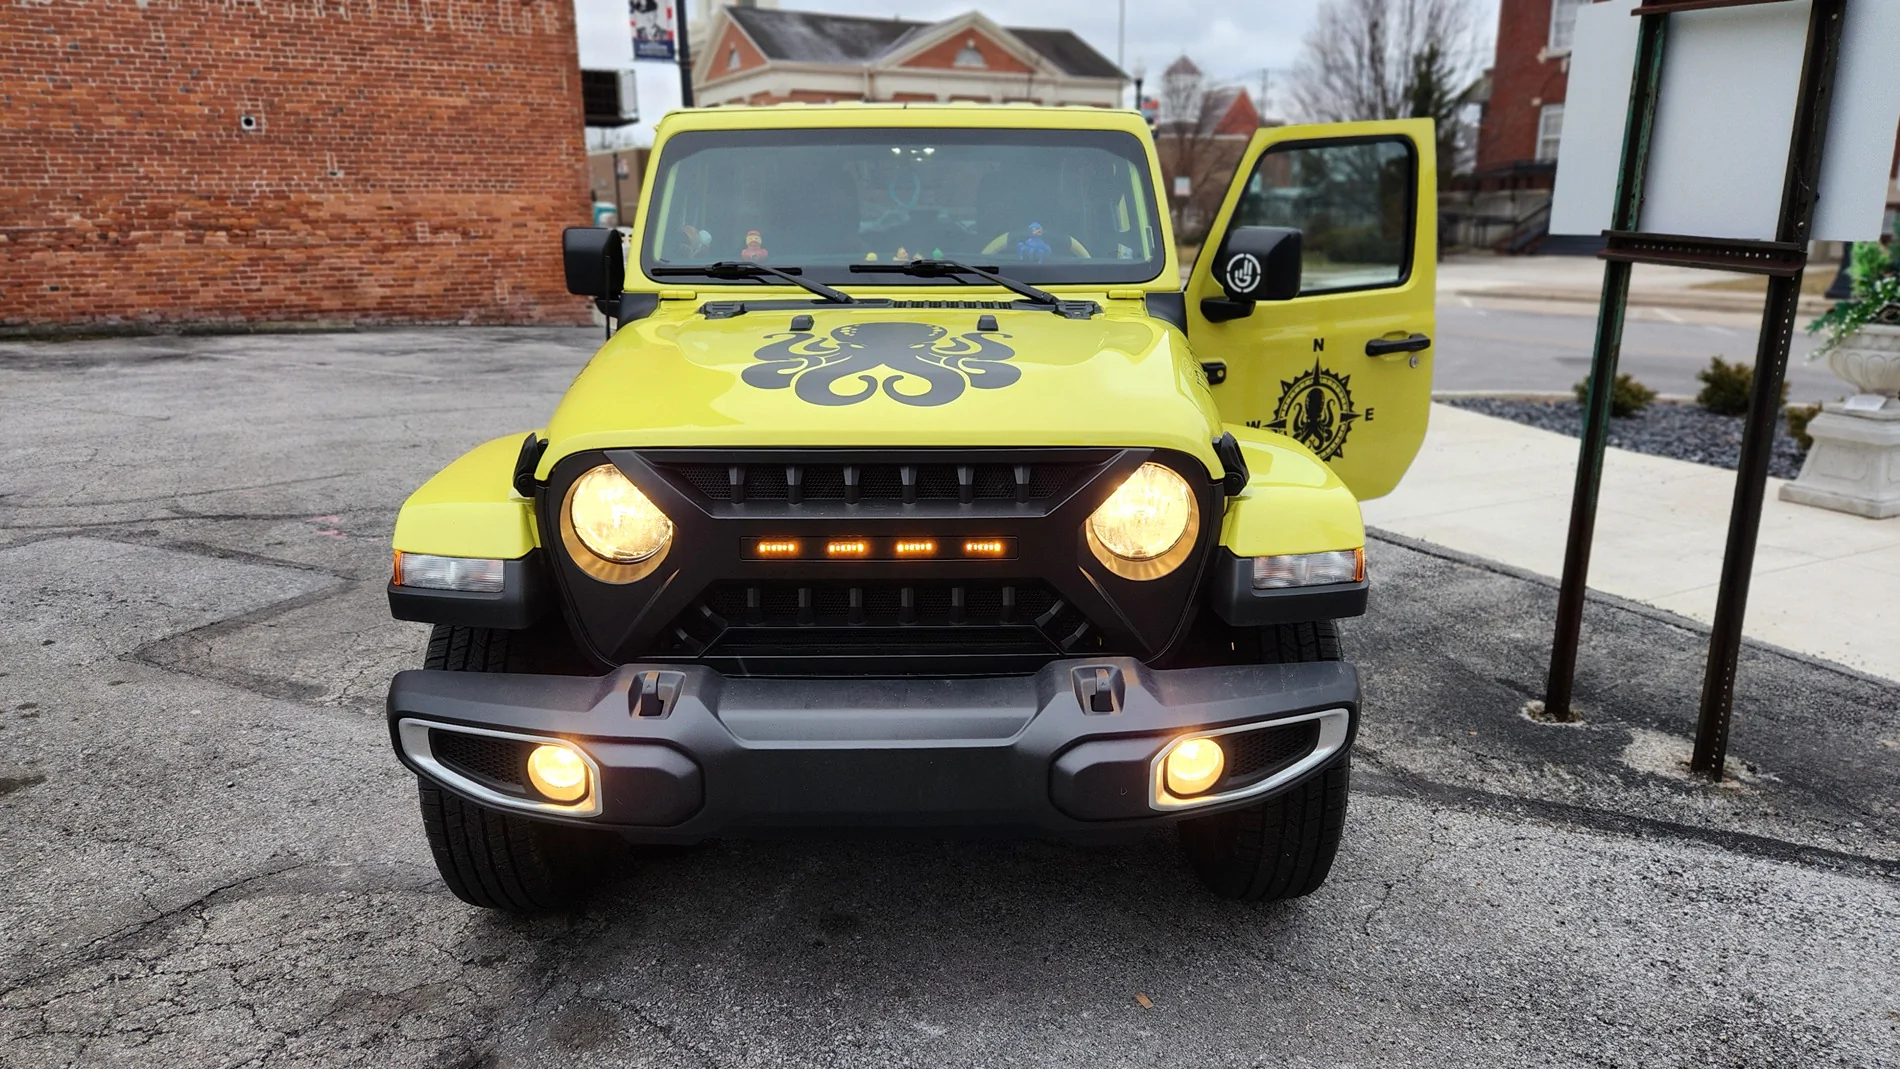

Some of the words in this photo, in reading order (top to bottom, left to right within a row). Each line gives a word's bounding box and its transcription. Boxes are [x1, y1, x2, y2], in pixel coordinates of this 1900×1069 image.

[1313, 337, 1325, 353] N
[1364, 407, 1375, 422] E
[1245, 419, 1261, 429] W
